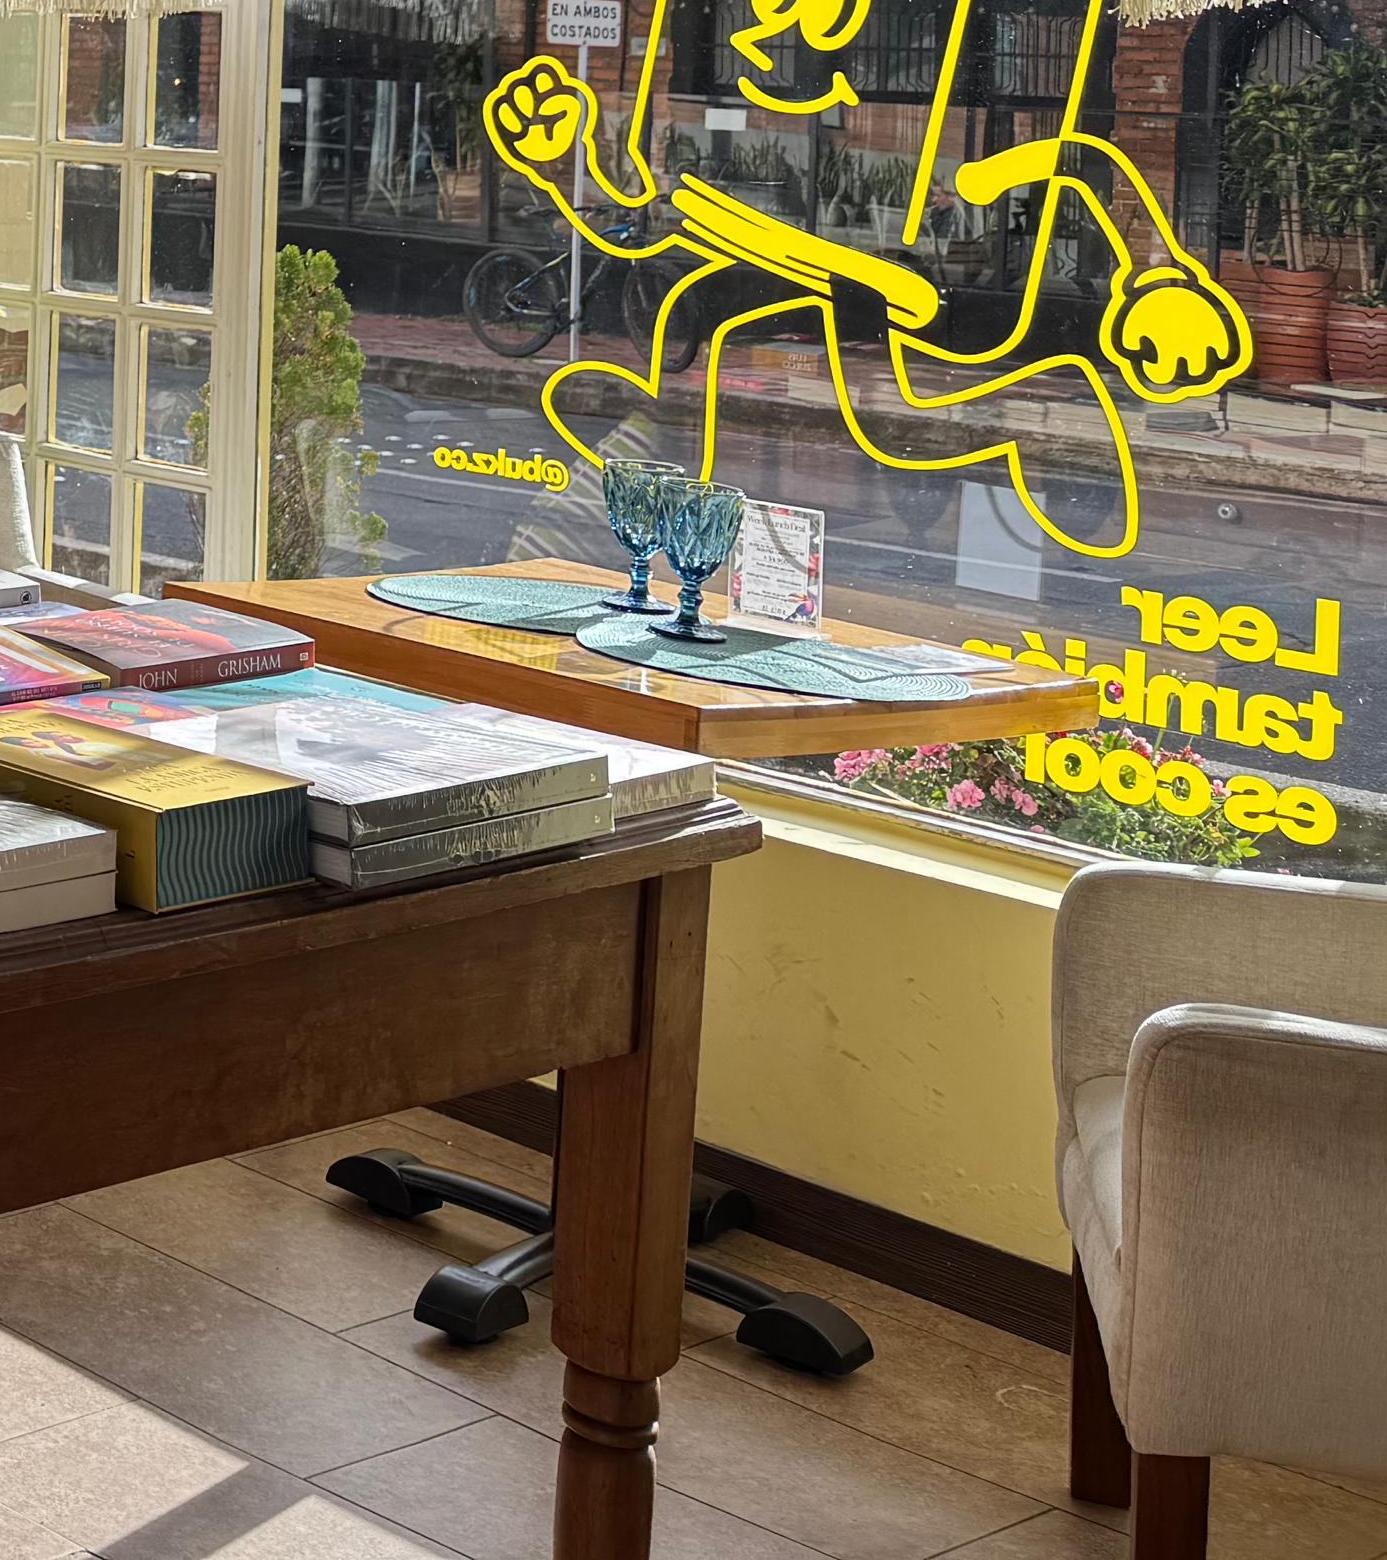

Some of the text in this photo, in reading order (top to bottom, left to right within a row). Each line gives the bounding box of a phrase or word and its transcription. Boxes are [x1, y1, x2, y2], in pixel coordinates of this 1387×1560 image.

[551, 3, 617, 20] EN AMBOS
[550, 23, 617, 40] COSTADOS
[138, 653, 282, 689] JOHN GRISHAM
